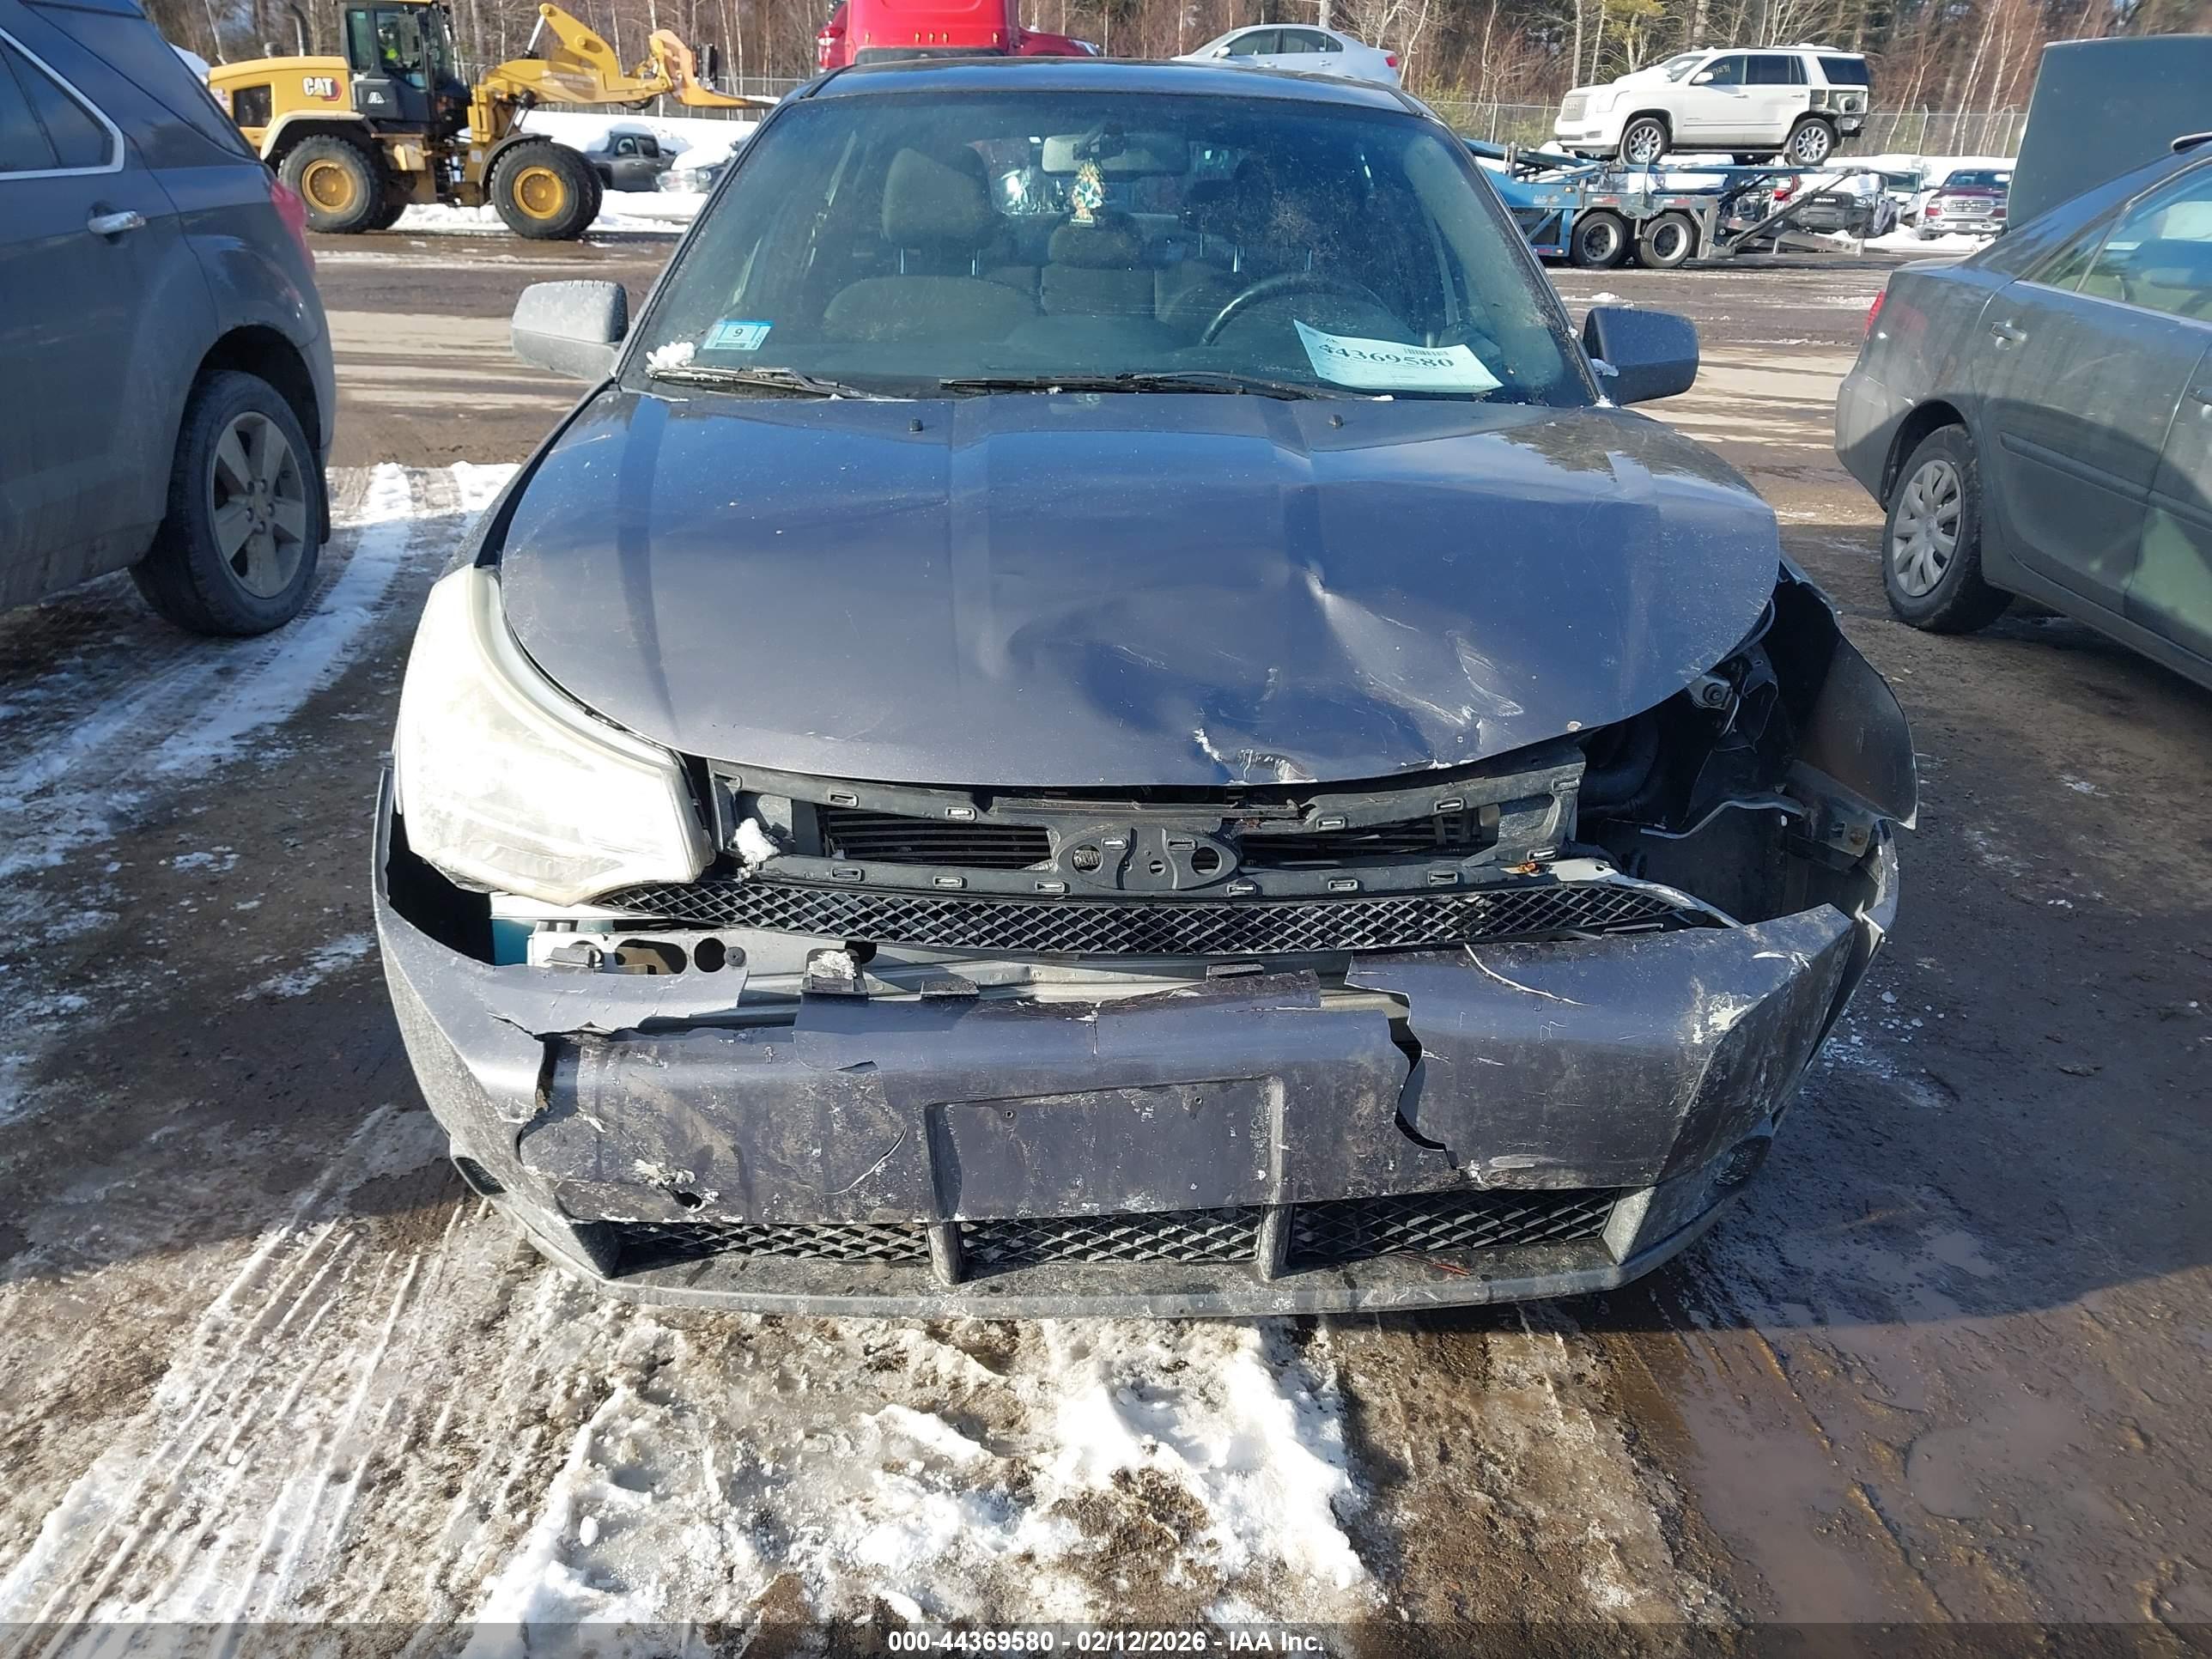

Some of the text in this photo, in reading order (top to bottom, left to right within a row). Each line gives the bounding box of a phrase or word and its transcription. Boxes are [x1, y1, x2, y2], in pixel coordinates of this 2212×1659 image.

[303, 76, 333, 97] CAT
[733, 328, 744, 337] 9
[1318, 343, 1455, 368] 44369580
